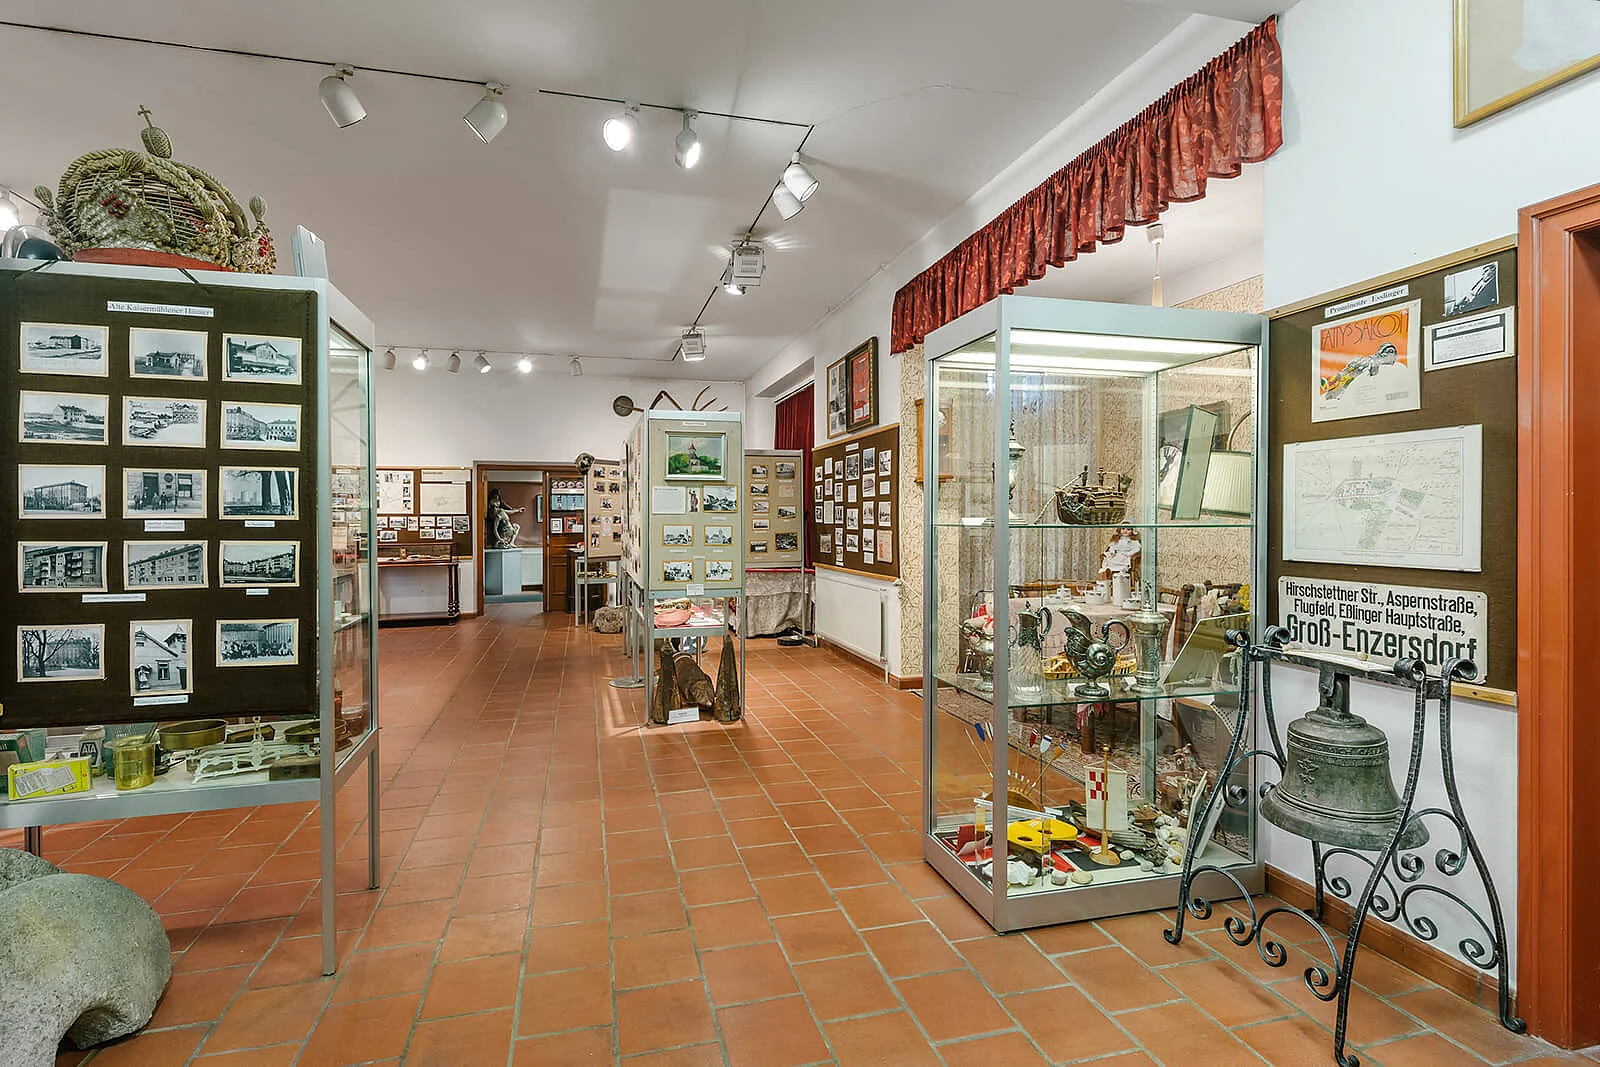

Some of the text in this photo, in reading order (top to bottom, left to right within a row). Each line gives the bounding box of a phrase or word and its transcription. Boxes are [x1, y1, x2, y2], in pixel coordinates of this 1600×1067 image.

[1286, 581, 1478, 617] Hirschstettner Str., Aspernstraße,
[1294, 598, 1465, 636] Flugfeld, Eßlinger Hauptstraße,
[1286, 613, 1477, 665] Groß-Enzersdorf
[81, 743, 97, 753] ATA
